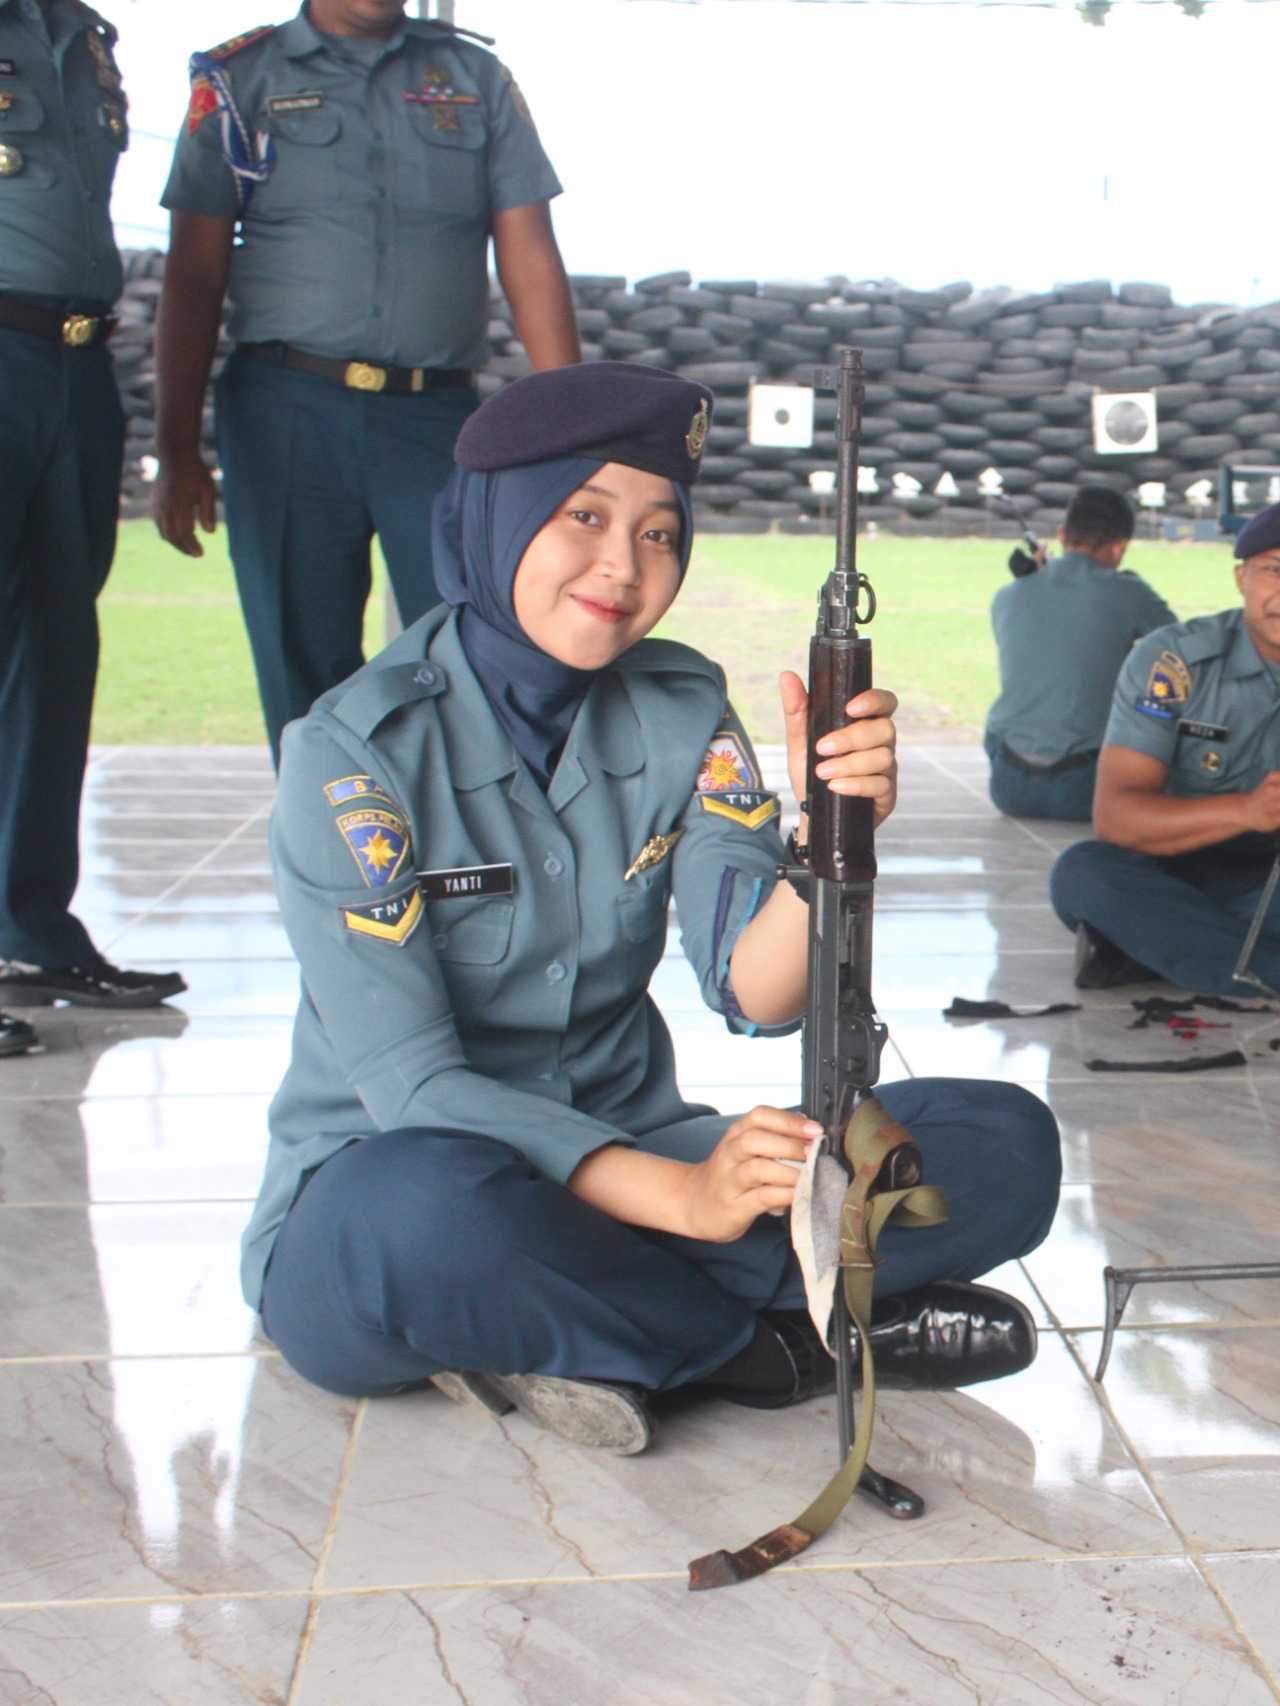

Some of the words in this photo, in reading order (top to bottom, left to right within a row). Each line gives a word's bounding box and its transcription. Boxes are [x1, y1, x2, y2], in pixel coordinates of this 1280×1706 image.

[725, 793, 762, 805] TNI
[342, 812, 376, 828] KORPS
[444, 875, 482, 892] YANTI
[370, 897, 408, 920] TNI
